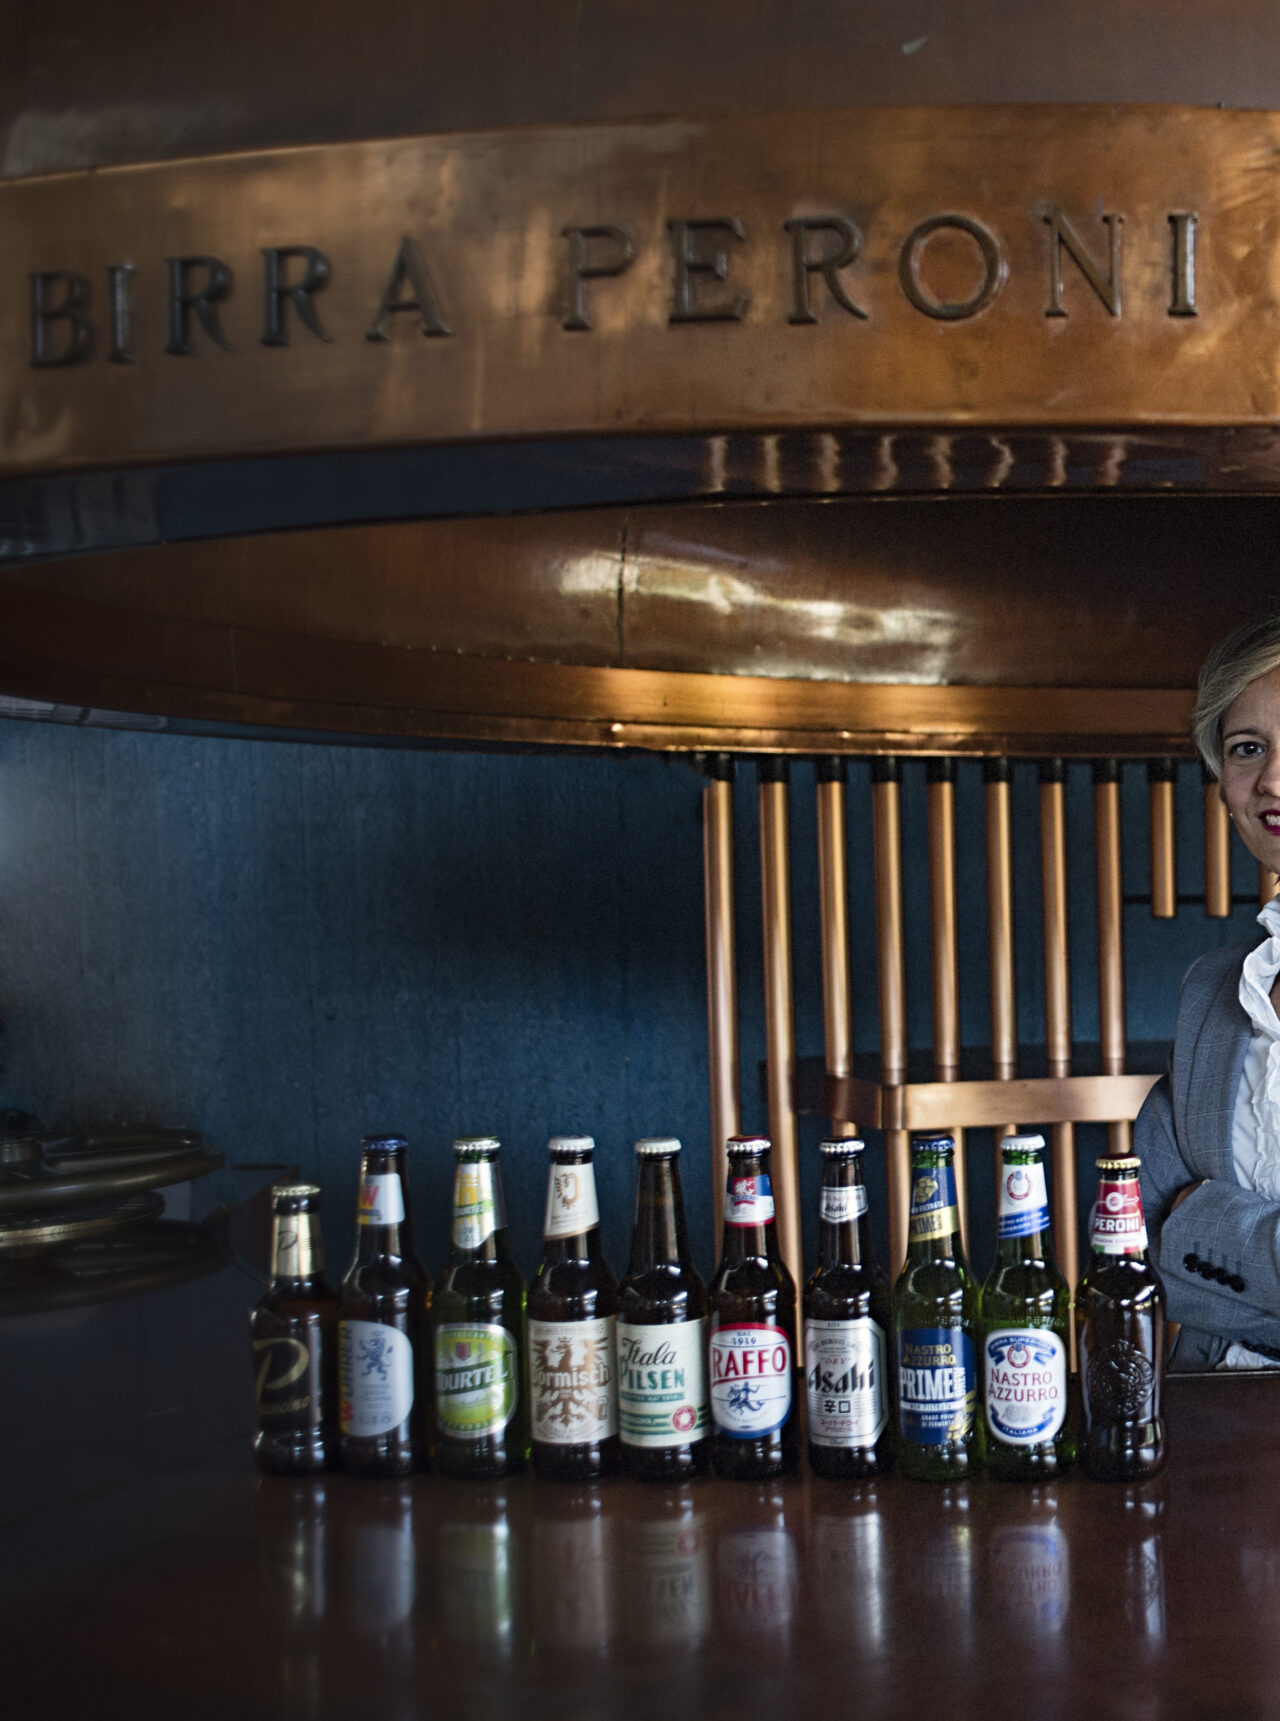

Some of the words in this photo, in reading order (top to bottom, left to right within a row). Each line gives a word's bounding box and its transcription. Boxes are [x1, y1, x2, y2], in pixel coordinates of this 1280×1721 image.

[28, 237, 453, 369] BIRRA
[560, 210, 1199, 332] PERONI
[1095, 1217, 1139, 1232] PERONI
[622, 1337, 677, 1366] Itala
[732, 1337, 757, 1346] 1919
[906, 1343, 952, 1355] NASTRO
[712, 1345, 787, 1378] RAFFO
[903, 1354, 957, 1367] AZZURRO
[619, 1355, 685, 1391] PILSEN
[808, 1360, 875, 1392] Asahi
[991, 1366, 1052, 1386] NASTRO
[900, 1367, 953, 1400] PRIME
[988, 1382, 1058, 1402] AZZURRO
[824, 1399, 851, 1414] 辛口
[1002, 1425, 1039, 1435] ITALIANA
